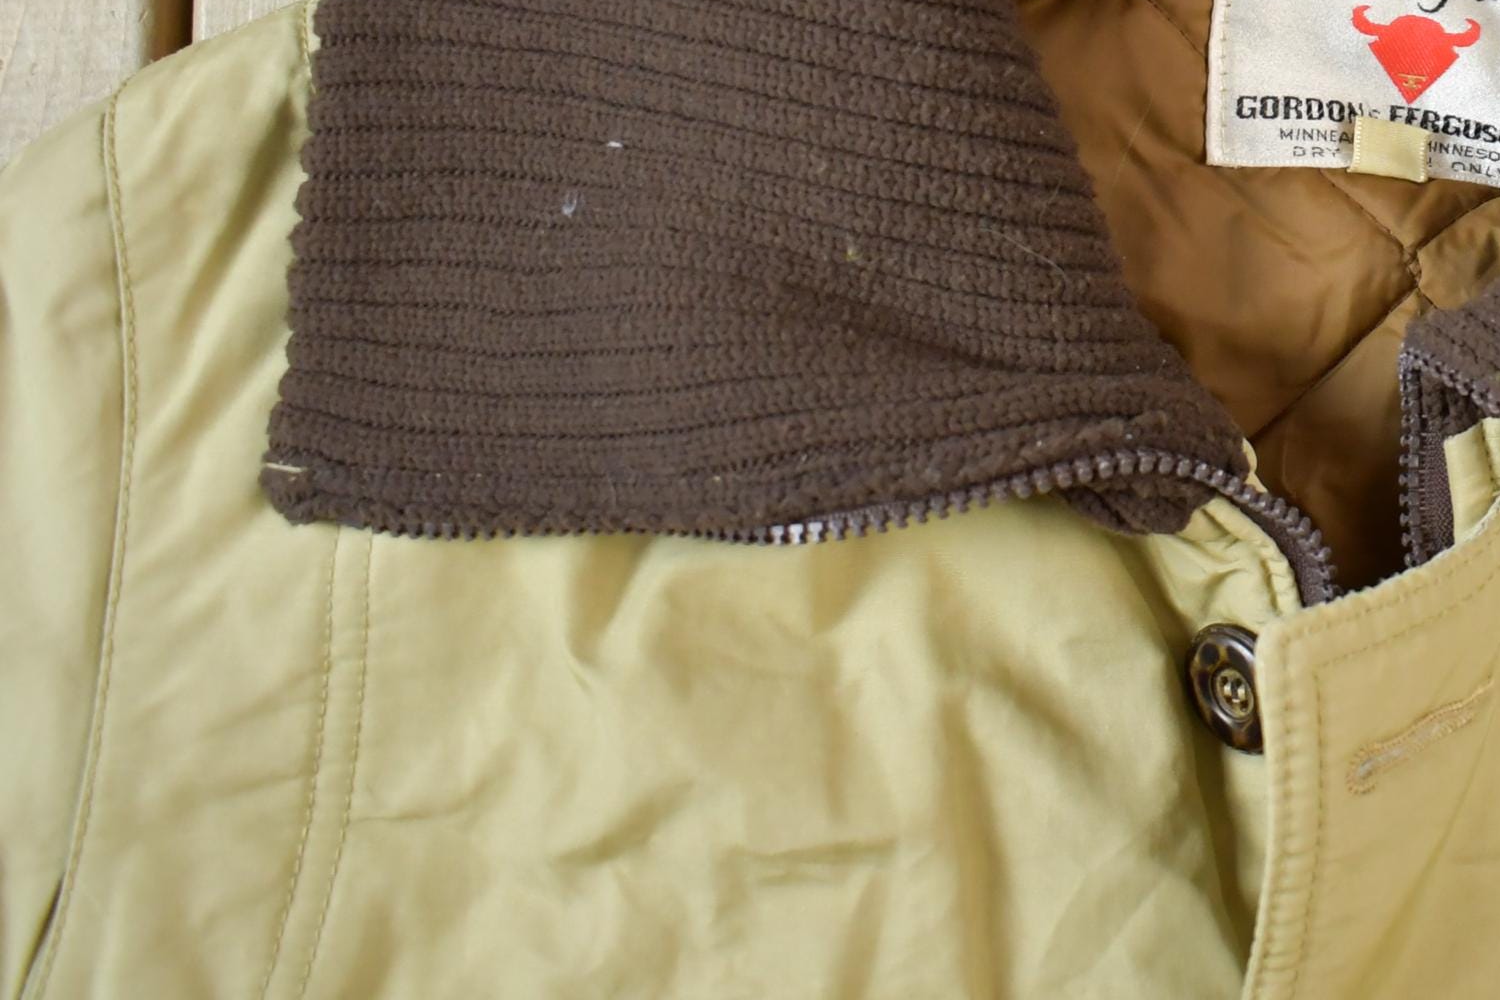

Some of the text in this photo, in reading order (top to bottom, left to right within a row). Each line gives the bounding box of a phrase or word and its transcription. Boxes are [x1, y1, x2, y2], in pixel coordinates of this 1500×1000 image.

[1235, 95, 1364, 124] GORDON
[1279, 128, 1355, 145] MINNEA
[1292, 145, 1341, 158] DRY
